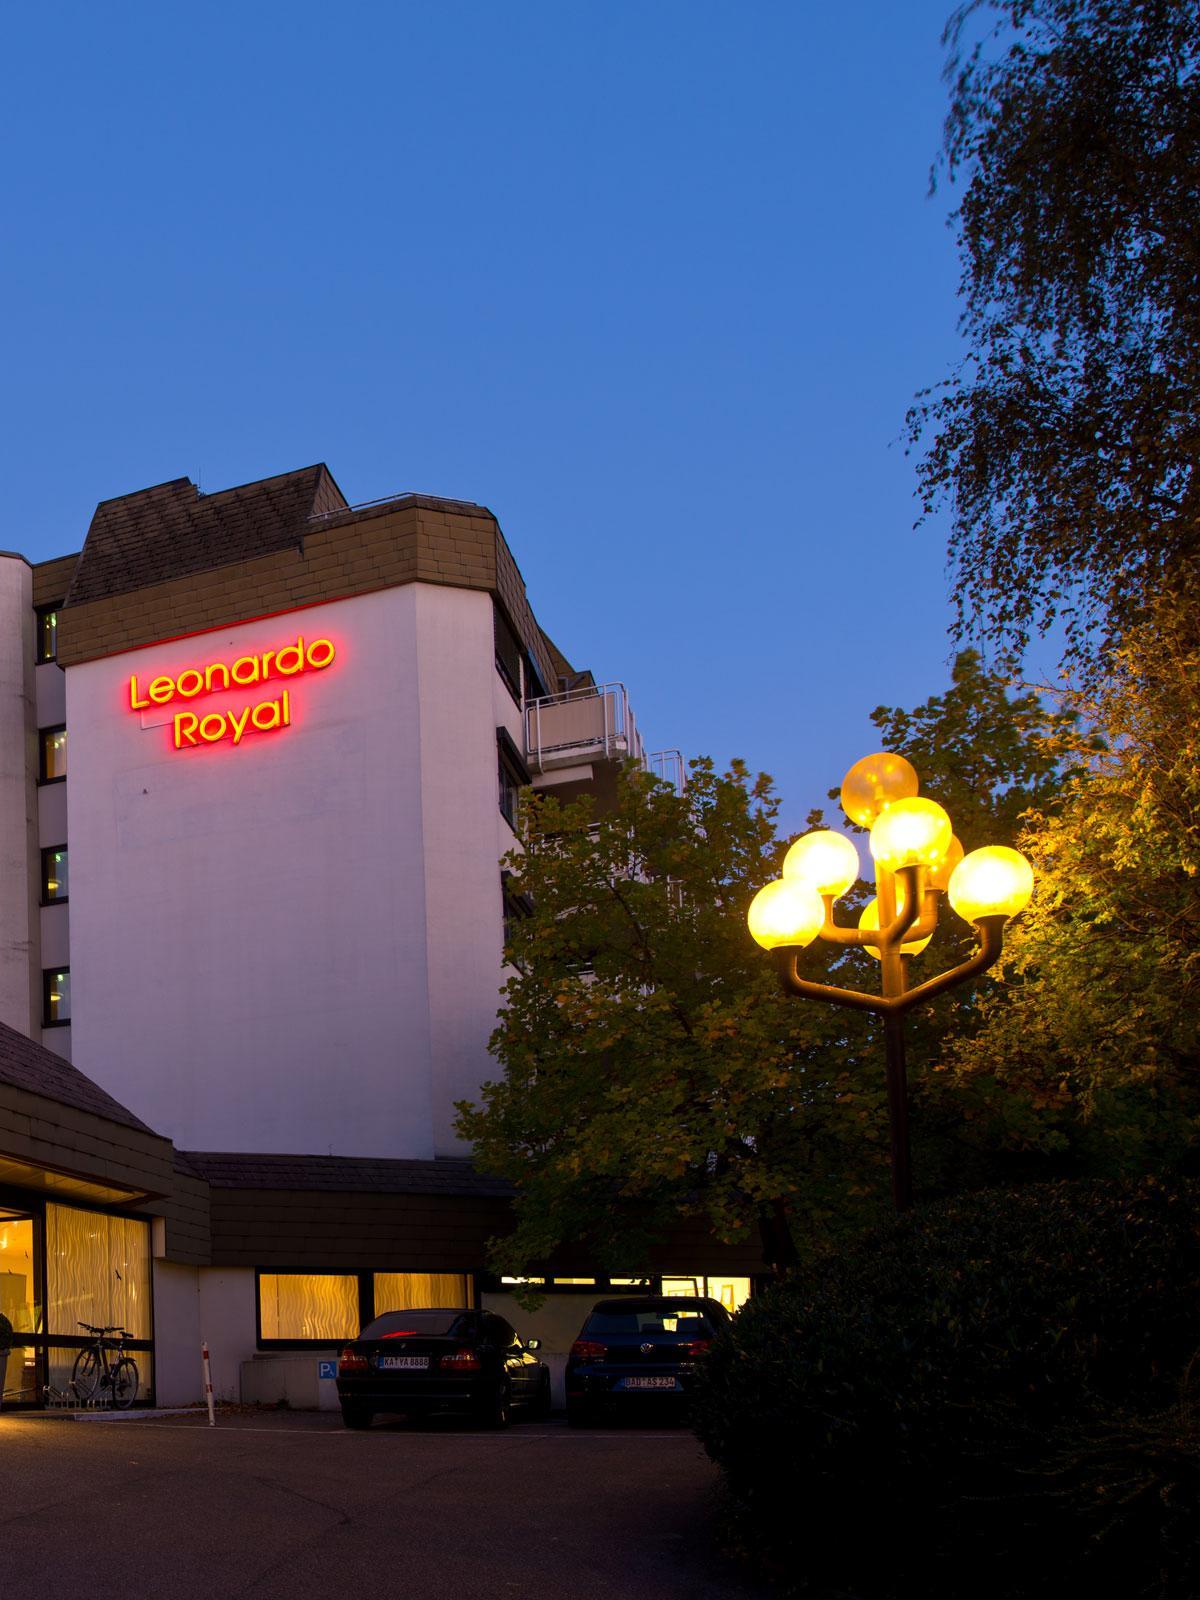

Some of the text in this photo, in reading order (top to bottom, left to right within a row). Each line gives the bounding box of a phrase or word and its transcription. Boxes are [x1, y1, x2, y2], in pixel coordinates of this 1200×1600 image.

[130, 636, 336, 709] Leonardo
[173, 689, 290, 748] Royal
[321, 1363, 330, 1376] P
